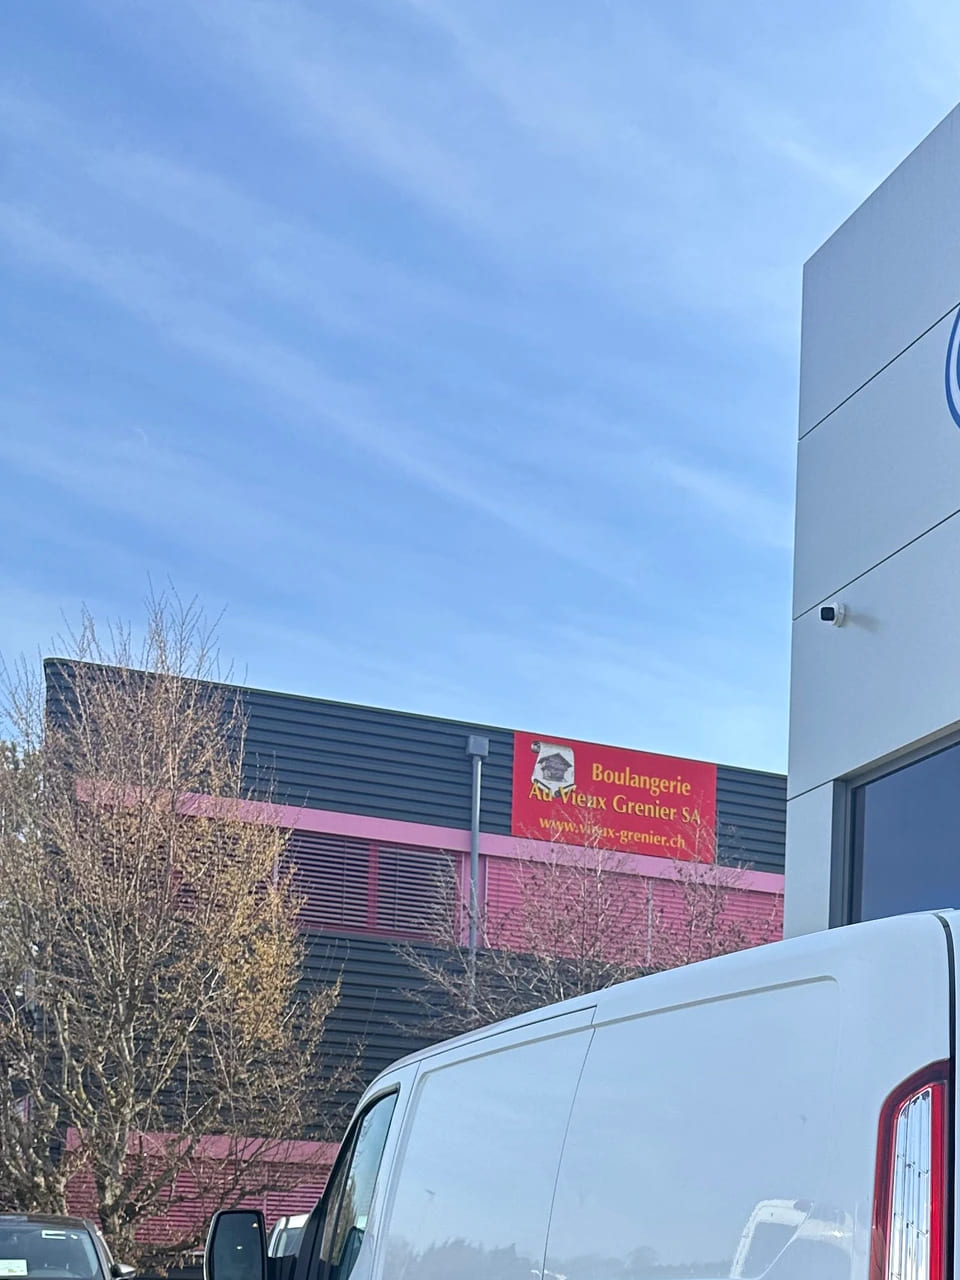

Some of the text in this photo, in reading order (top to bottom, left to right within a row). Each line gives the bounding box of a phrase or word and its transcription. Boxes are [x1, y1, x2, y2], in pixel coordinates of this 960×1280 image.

[592, 763, 692, 796] Boulangerie
[529, 782, 701, 824] Au Vieux Grenier SA
